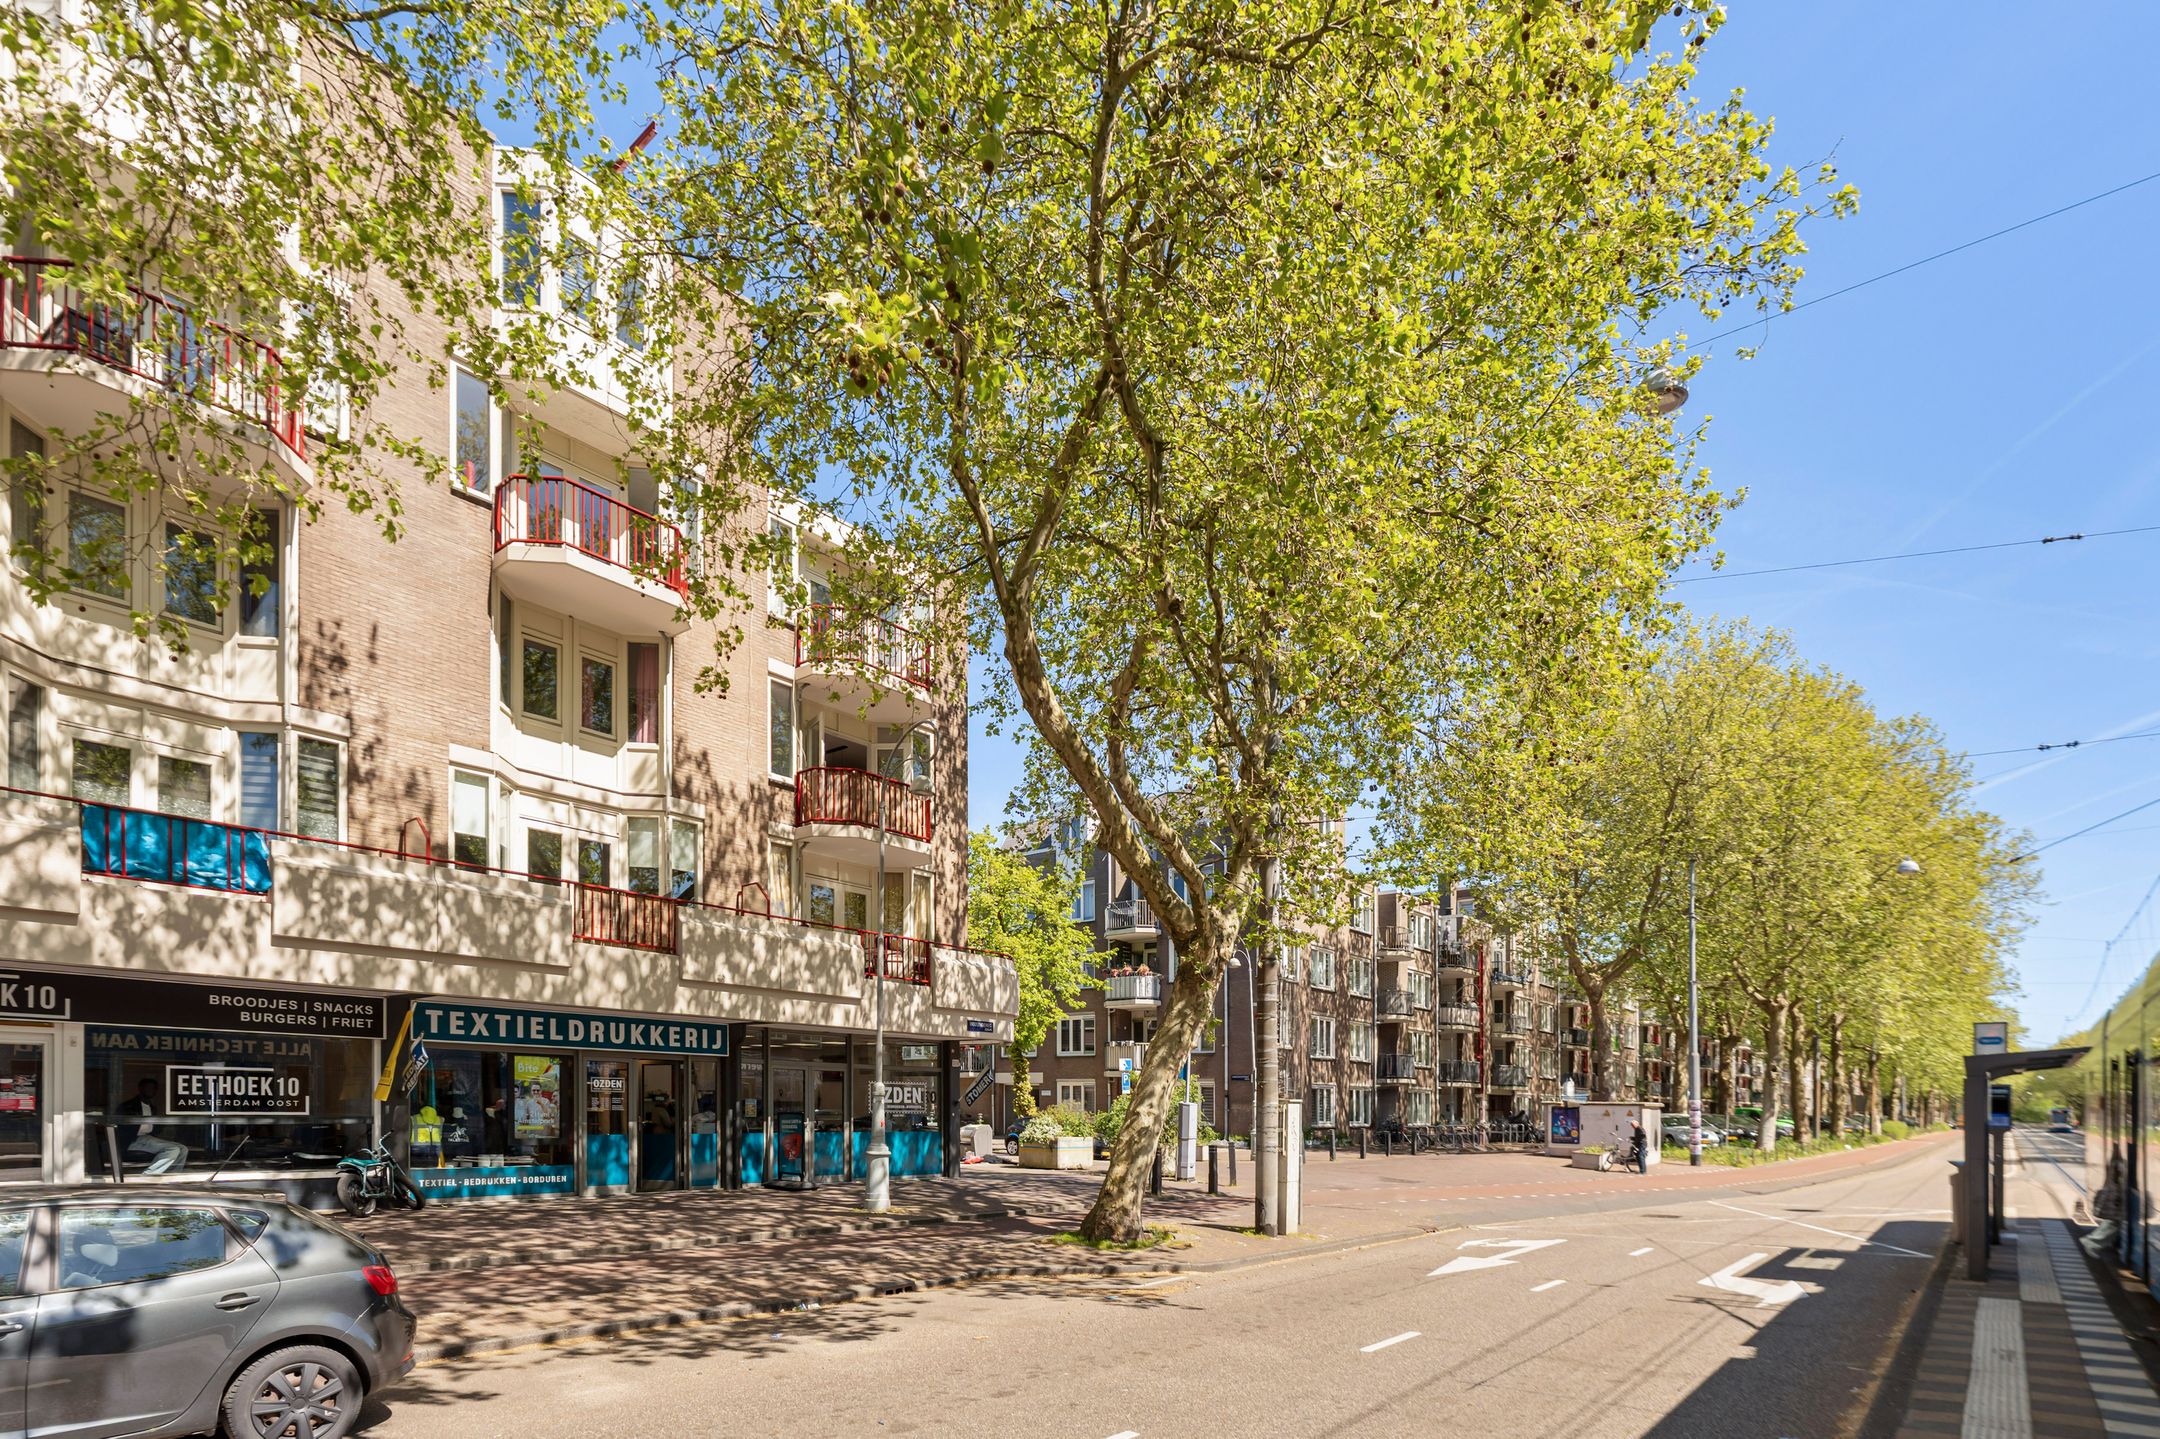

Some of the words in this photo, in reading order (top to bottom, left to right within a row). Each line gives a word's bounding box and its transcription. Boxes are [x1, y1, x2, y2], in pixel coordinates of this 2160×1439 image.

[209, 995, 298, 1011] BROODJES
[313, 1002, 374, 1015] SNACKS
[240, 1011, 317, 1026] BURGERS
[332, 1017, 374, 1029] FRIET
[425, 1009, 722, 1050] TEXTIELDRUKKERIJ
[593, 1079, 622, 1088] OZDEN
[178, 1099, 260, 1107] AMSTERDAM
[266, 1099, 299, 1107] OOST
[883, 1086, 922, 1104] ZDEN
[419, 1178, 457, 1187] TEXTIEL
[464, 1176, 516, 1186] BEDRUKKEN
[523, 1174, 567, 1184] BORDUREN
